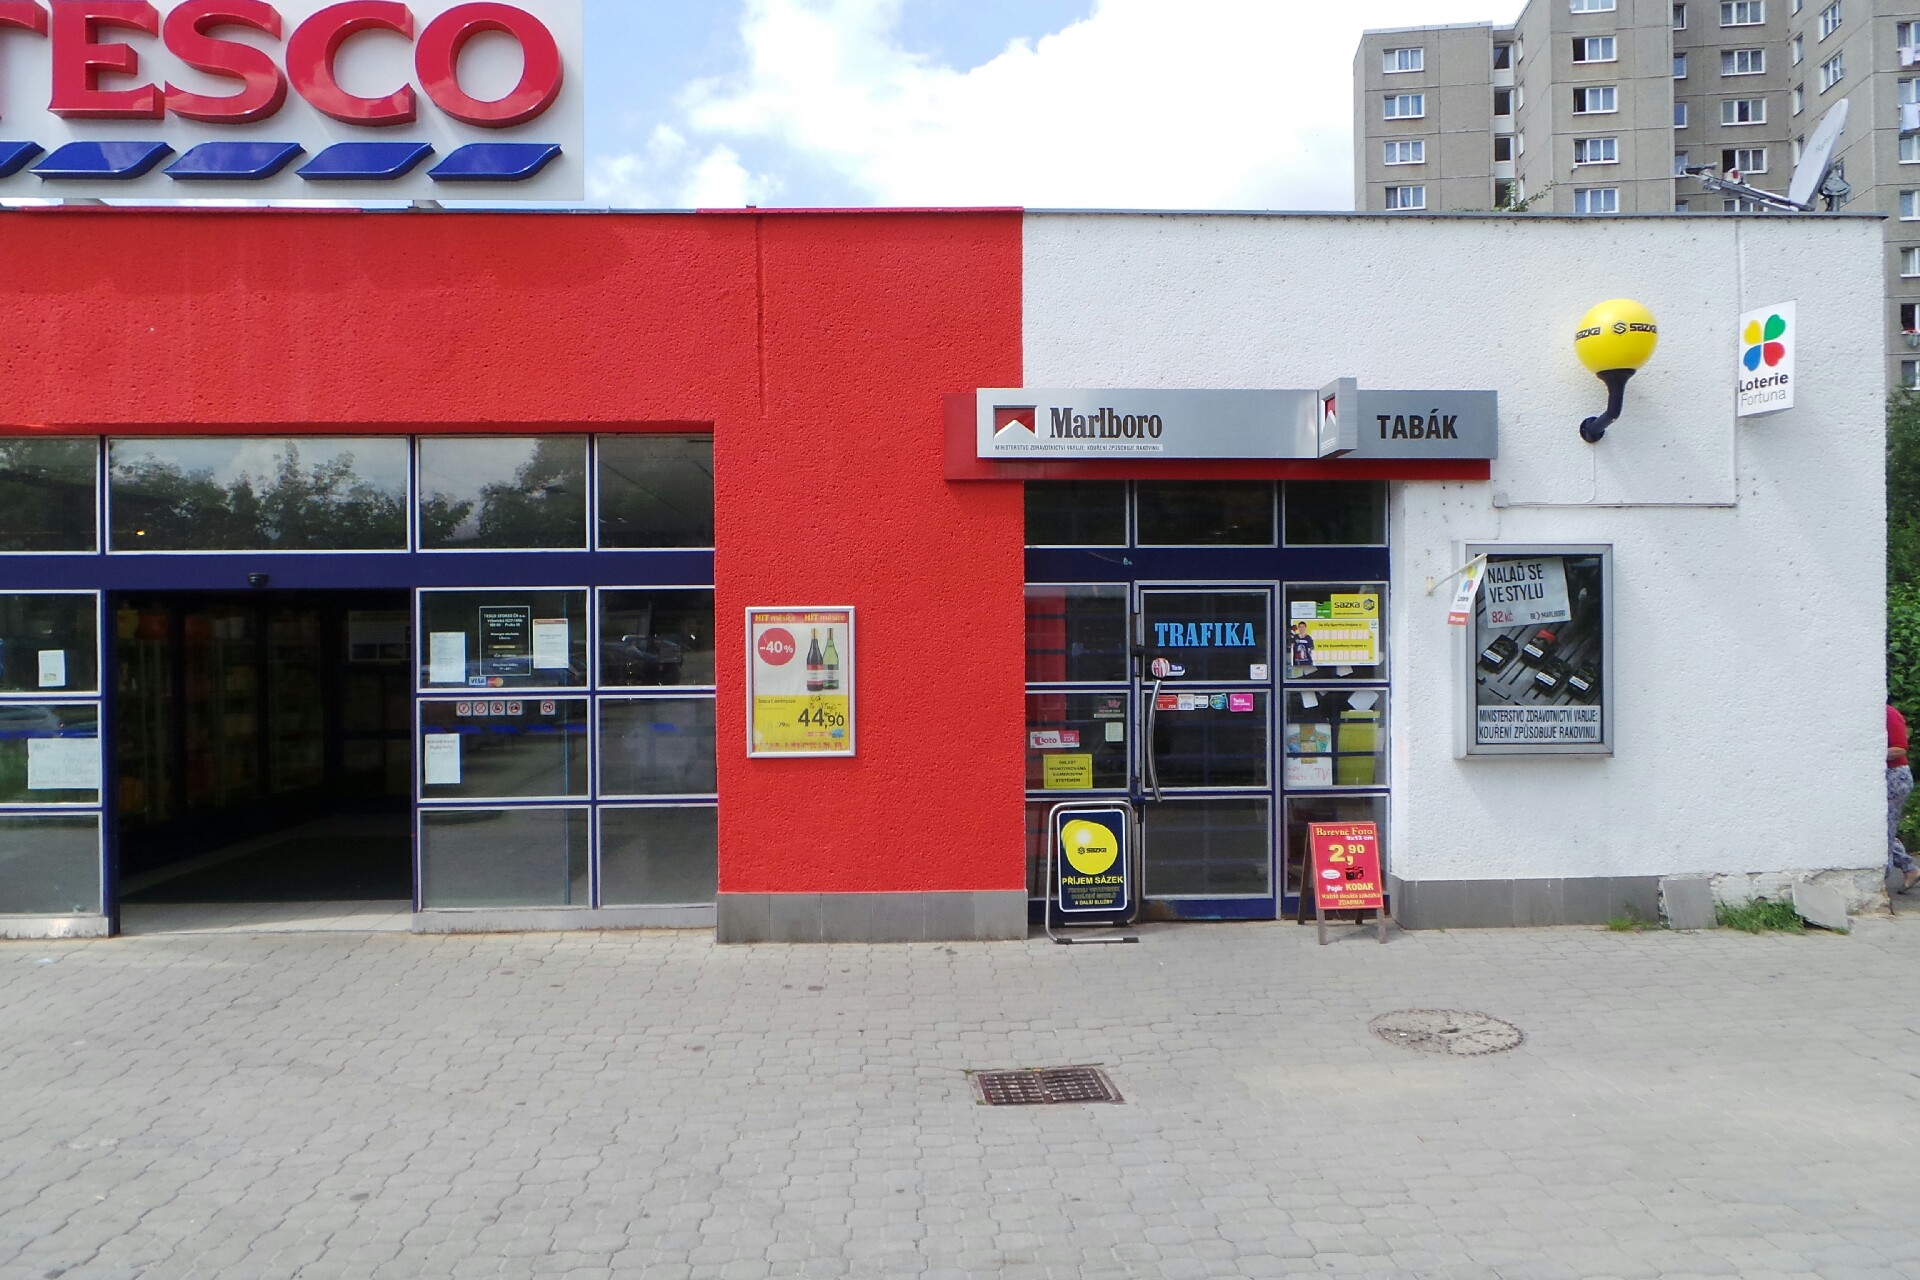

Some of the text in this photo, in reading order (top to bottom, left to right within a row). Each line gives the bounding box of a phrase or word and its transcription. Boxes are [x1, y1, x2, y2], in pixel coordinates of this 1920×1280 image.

[1739, 372, 1789, 392] Loterie
[1740, 389, 1787, 407] Fortuna
[1049, 407, 1163, 439] Marlboro
[1377, 408, 1458, 440] TABÁK
[1488, 562, 1544, 584] NALAĎ SE
[1489, 583, 1544, 603] VE STYLU
[755, 614, 770, 622] HIT
[804, 613, 819, 621] HIT
[1491, 611, 1504, 623] 82
[1541, 610, 1566, 619] MARLBORO
[1154, 622, 1256, 648] TRAFIKA
[797, 708, 845, 729] 44,90
[1479, 708, 1598, 723] MINISTERSTVO ZDRAVOTNICTVÍ VARUJE:
[1479, 723, 1597, 739] KOUŘENÍ ZPŮSOBUJE RAKOVINU.
[1316, 827, 1373, 836] Barevné Foto
[1062, 875, 1124, 885] PŘÍJEM SÁZEK
[1345, 883, 1374, 891] KODAK
